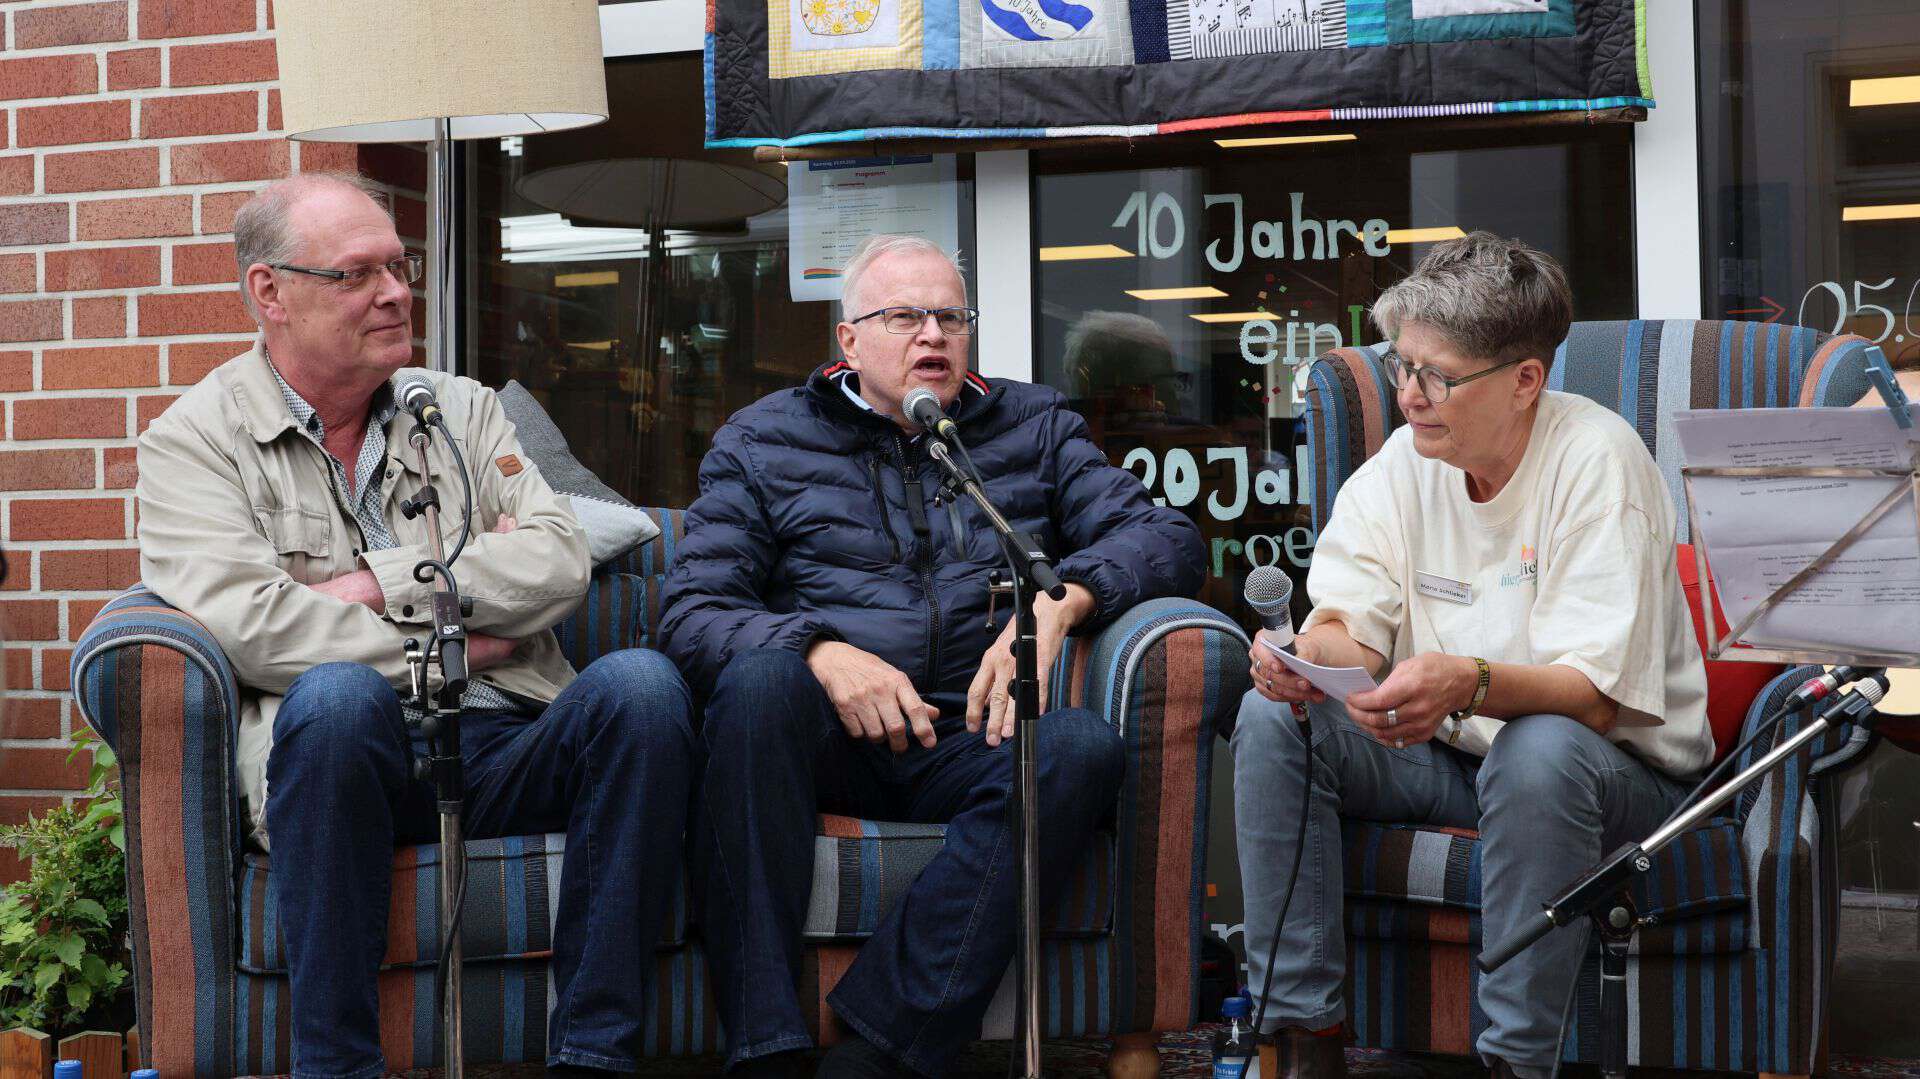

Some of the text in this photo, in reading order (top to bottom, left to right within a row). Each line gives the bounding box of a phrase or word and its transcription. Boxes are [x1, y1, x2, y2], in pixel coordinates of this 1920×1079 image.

[1021, 0, 1048, 29] Jahre
[1112, 190, 1392, 273] 10 Jahre
[1121, 446, 1201, 508] 20
